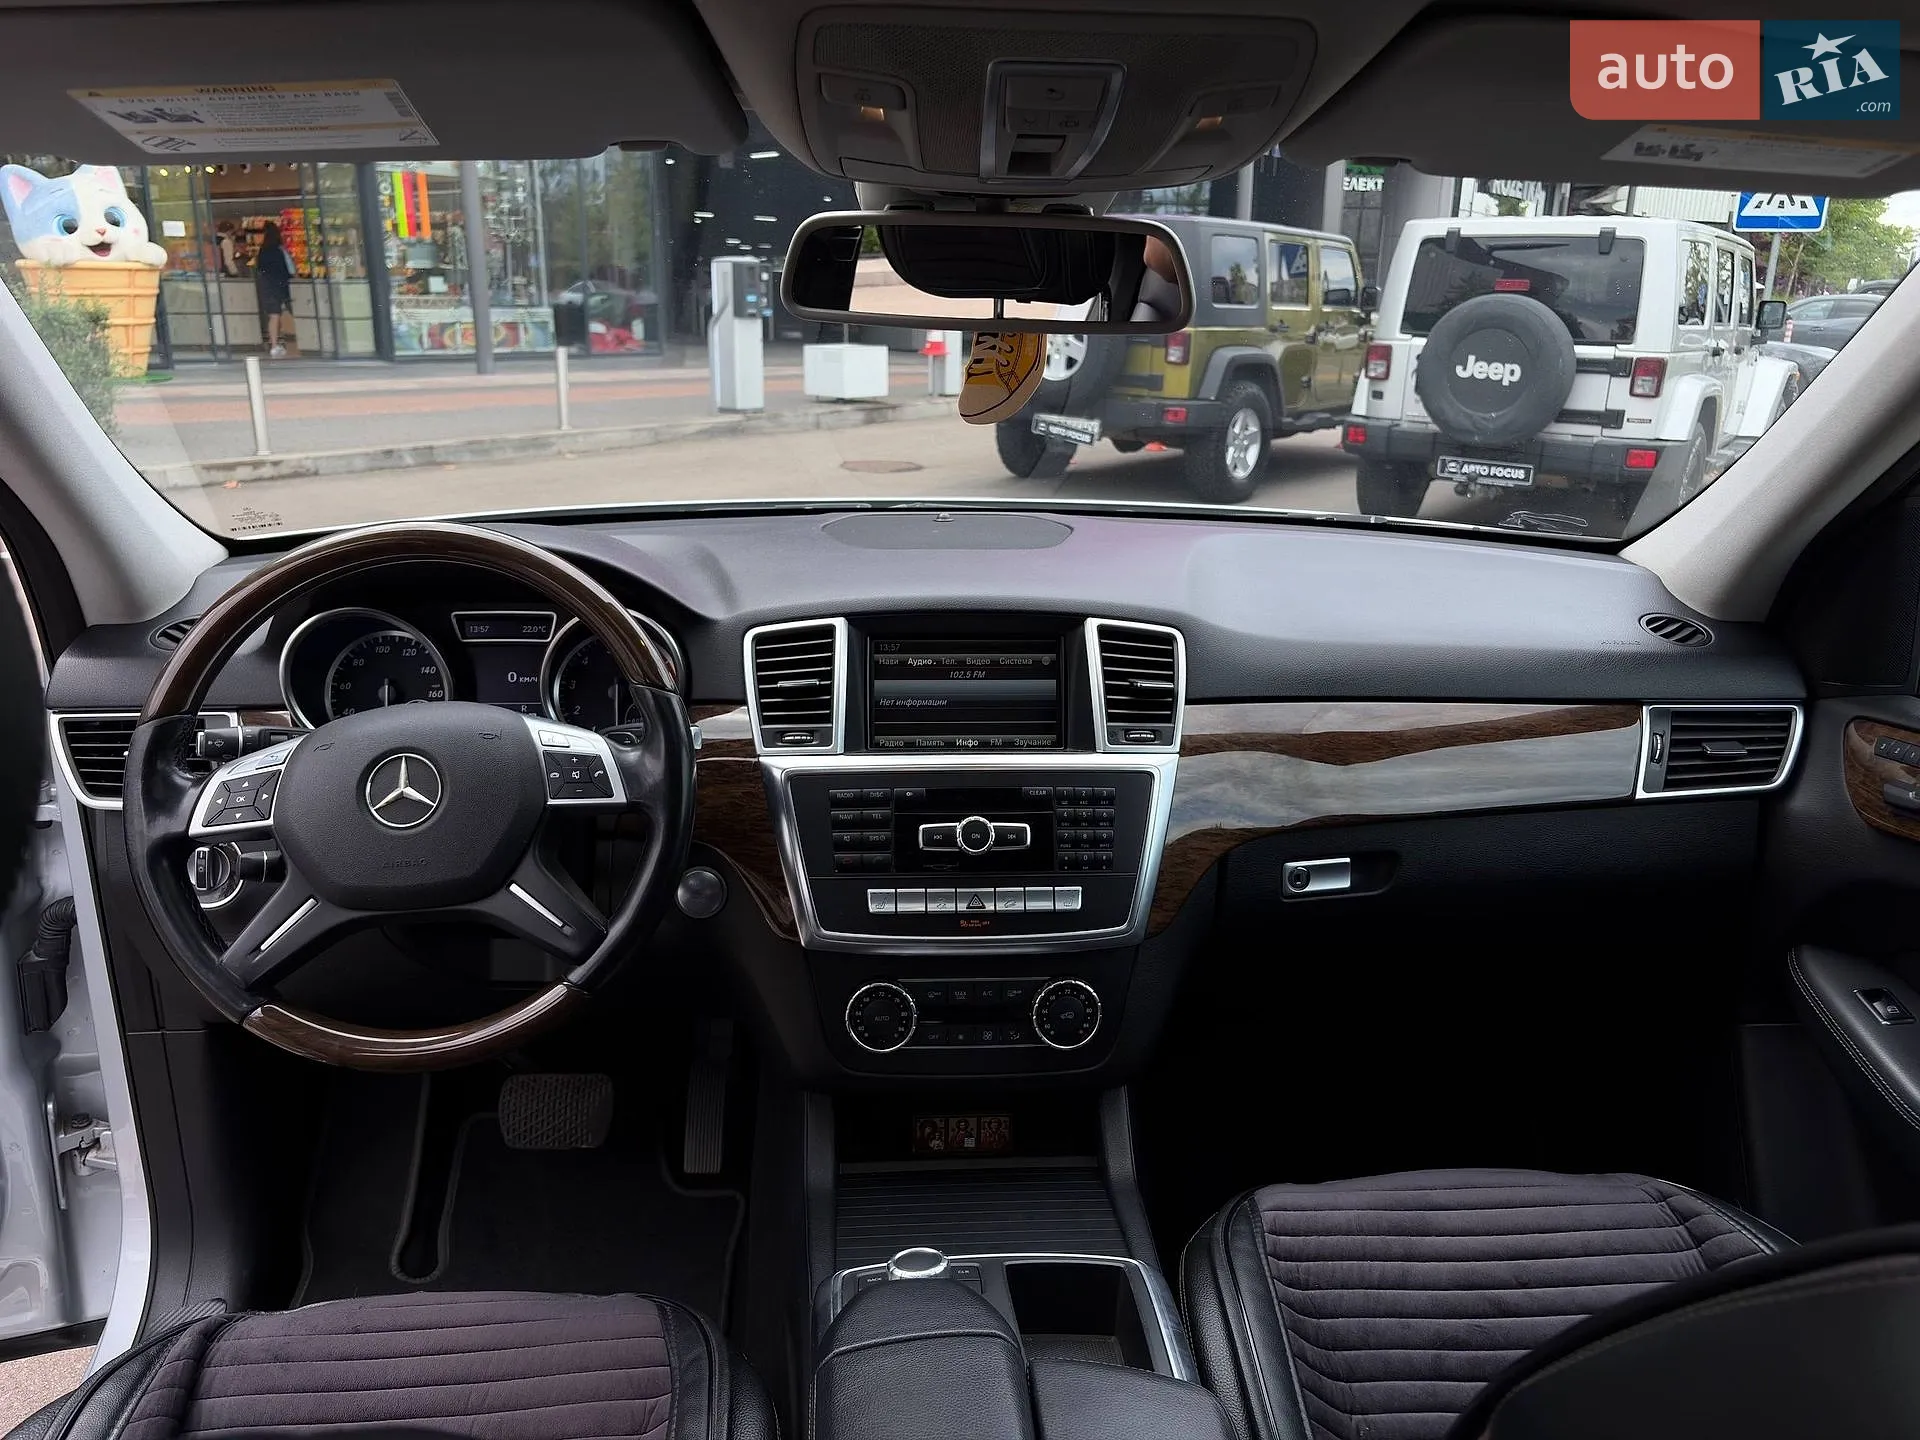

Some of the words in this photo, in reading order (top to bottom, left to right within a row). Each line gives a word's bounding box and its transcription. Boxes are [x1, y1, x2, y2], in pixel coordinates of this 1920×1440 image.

[196, 84, 276, 95] WARNING
[1455, 354, 1522, 387] Jeep
[1490, 466, 1525, 479] FOCUS
[375, 645, 391, 654] 100
[402, 647, 417, 657] 120
[907, 657, 933, 667] Аудио
[966, 657, 991, 666] Видео
[999, 656, 1033, 666] Система
[420, 665, 437, 675] 140
[949, 670, 971, 679] 102.5
[973, 670, 986, 679] FM
[508, 671, 517, 682] 0
[427, 689, 444, 699] 160
[879, 697, 895, 706] Нет
[896, 698, 948, 708] информации
[521, 704, 528, 712] R
[573, 705, 581, 715] 2
[879, 738, 904, 748] Радио
[916, 738, 945, 747] Память
[956, 738, 979, 748] Инфо
[990, 738, 1003, 746] FM
[235, 795, 246, 803] OK
